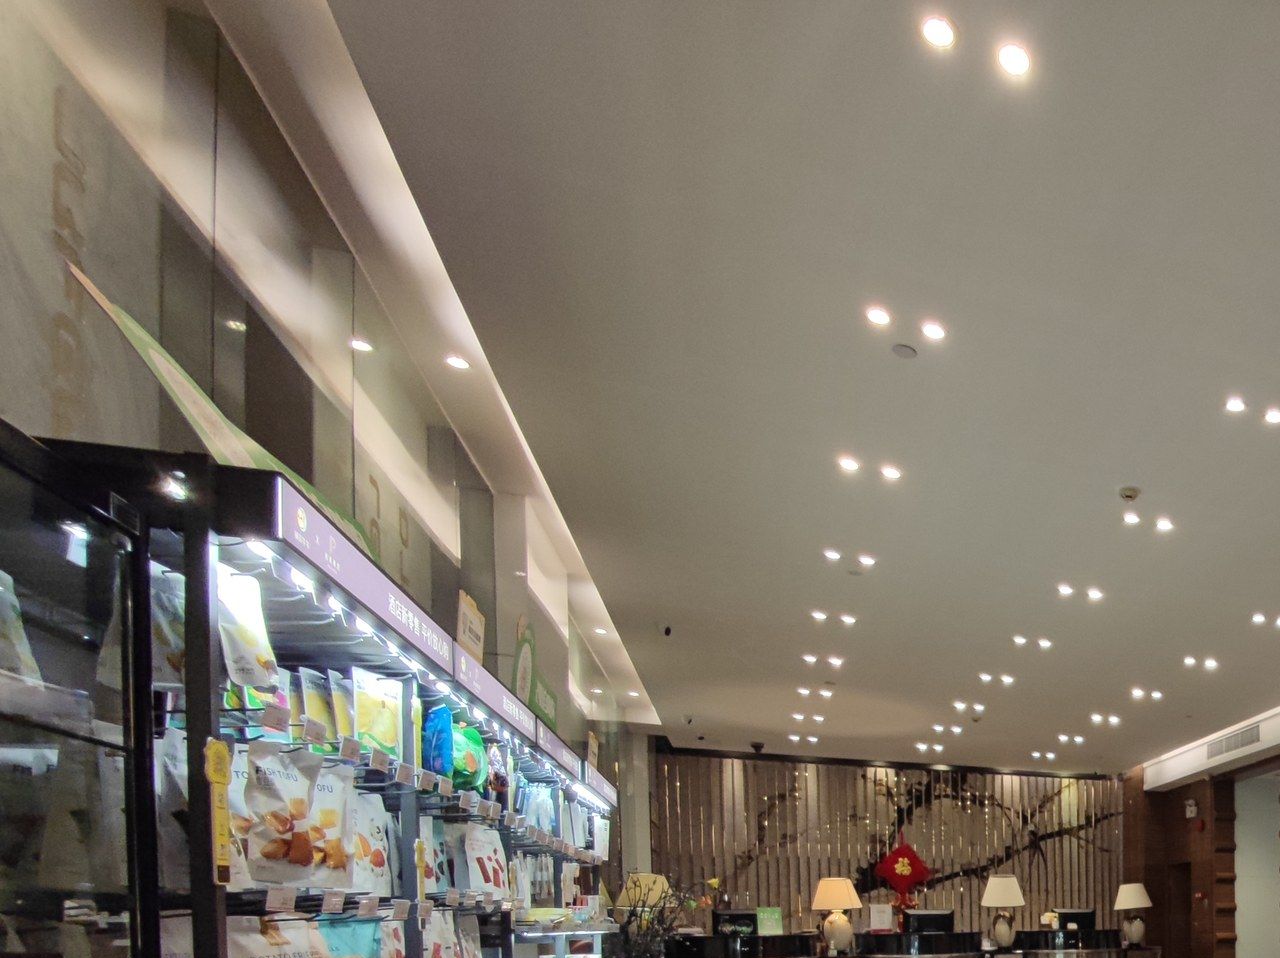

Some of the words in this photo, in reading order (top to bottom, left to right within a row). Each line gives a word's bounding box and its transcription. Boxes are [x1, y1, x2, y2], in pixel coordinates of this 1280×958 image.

[255, 765, 276, 776] FISH
[276, 770, 298, 782] TOFU
[894, 857, 912, 876] 福
